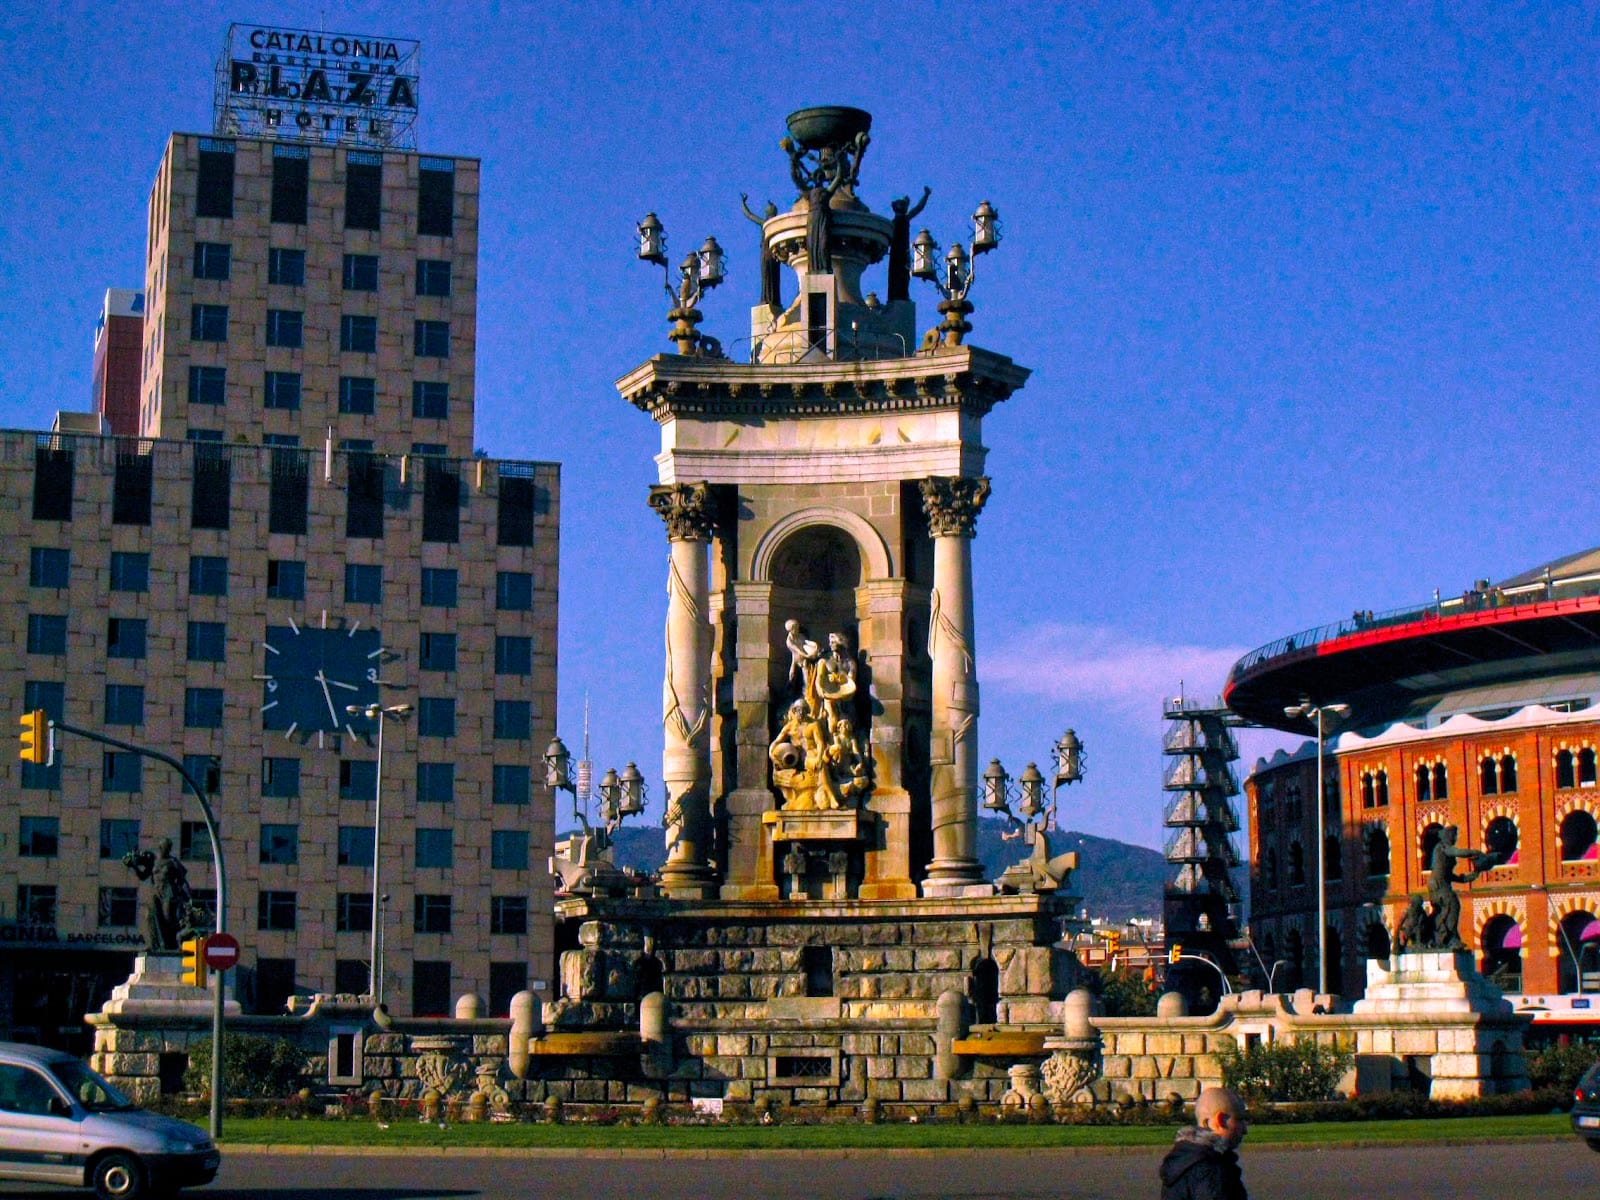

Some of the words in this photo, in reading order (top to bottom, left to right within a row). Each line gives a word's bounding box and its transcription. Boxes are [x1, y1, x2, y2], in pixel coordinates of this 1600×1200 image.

[250, 30, 398, 60] CATALONIA
[231, 62, 416, 107] PLAZA
[267, 109, 381, 134] HOTEL
[366, 668, 377, 681] 3
[267, 680, 278, 693] 9
[67, 933, 145, 944] BARCELONA
